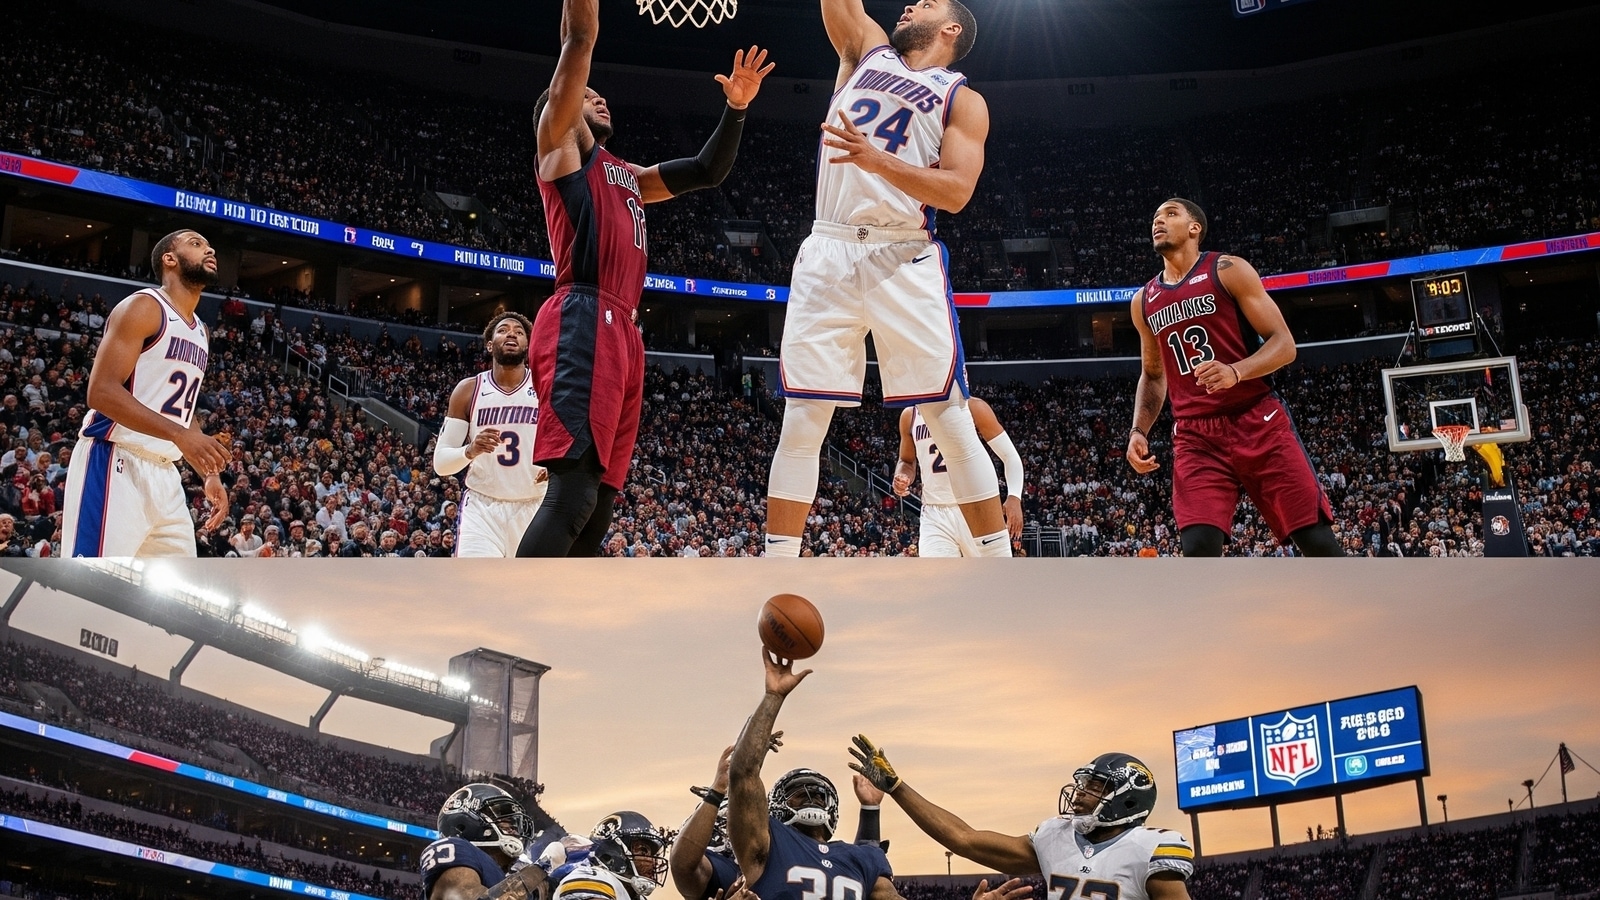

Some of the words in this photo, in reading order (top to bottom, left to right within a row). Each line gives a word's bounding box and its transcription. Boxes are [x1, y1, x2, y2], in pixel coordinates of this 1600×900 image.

[848, 98, 914, 154] 24
[1168, 326, 1215, 375] 13
[160, 370, 200, 422] 24
[1269, 742, 1315, 774] NFL
